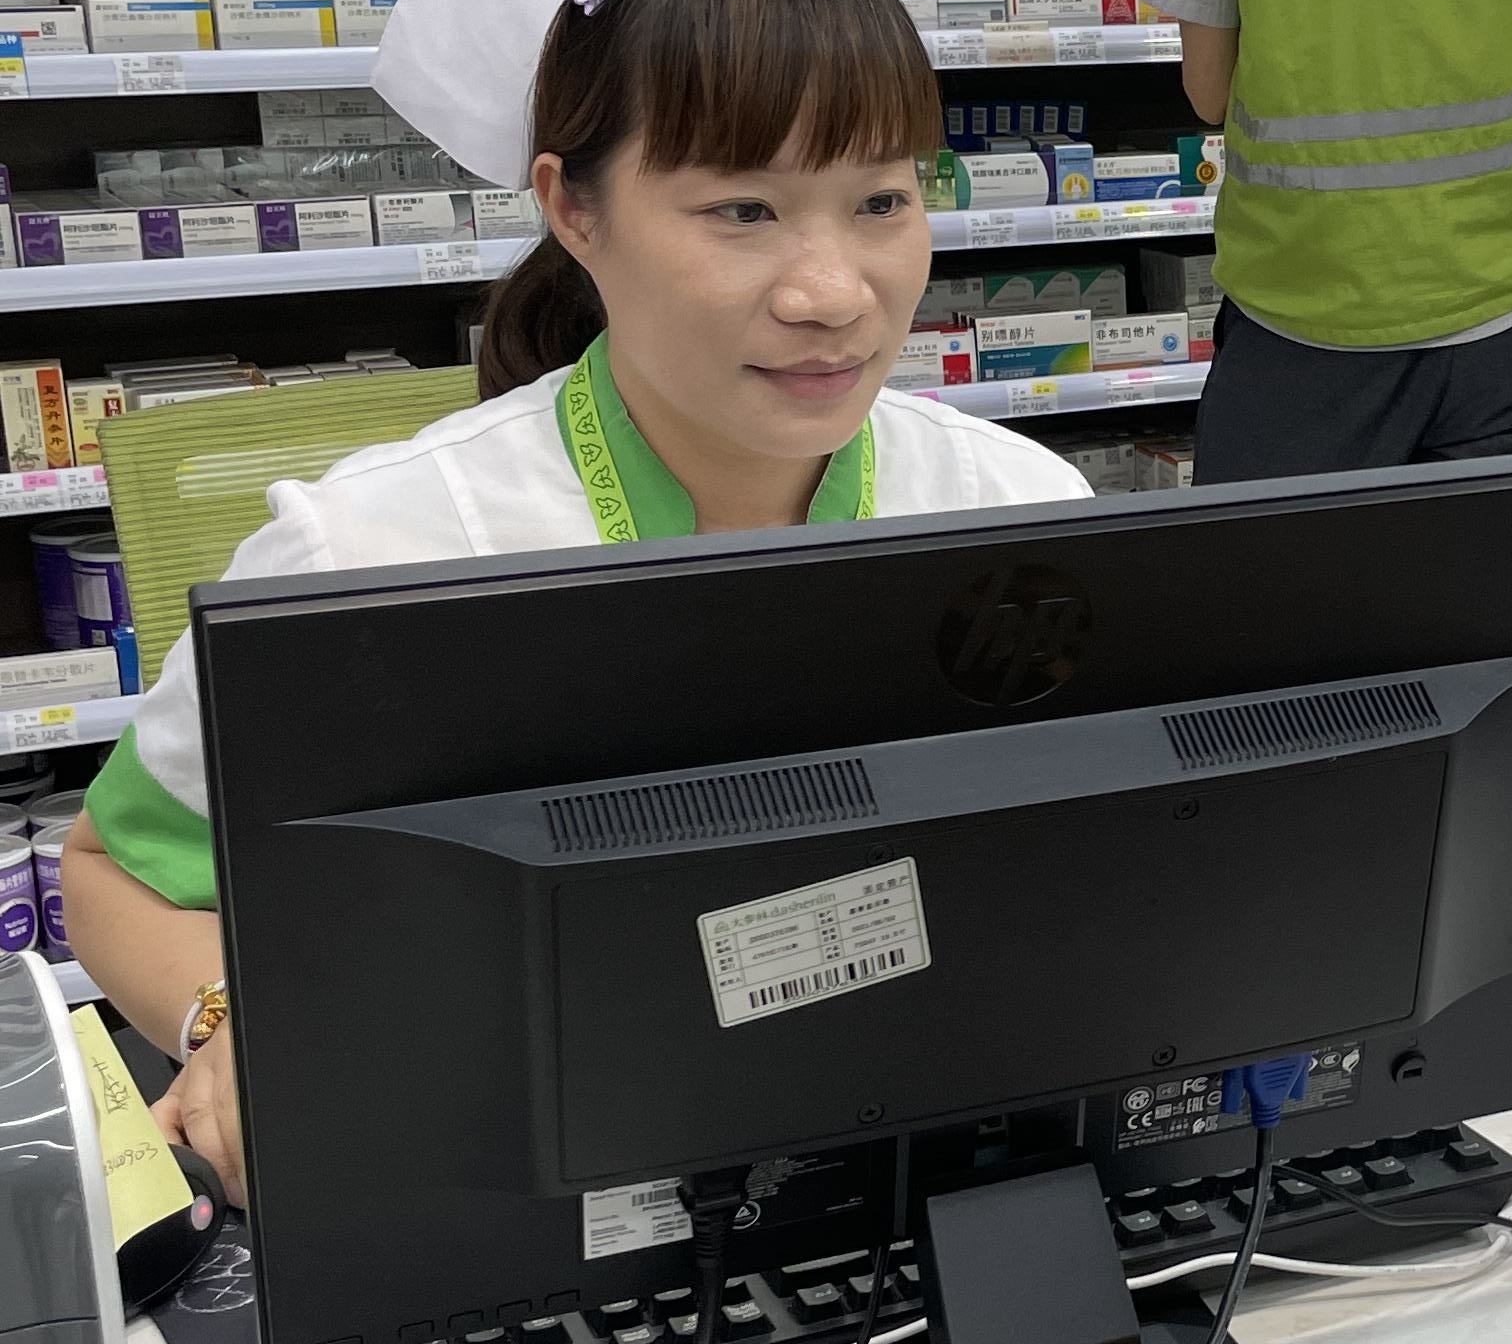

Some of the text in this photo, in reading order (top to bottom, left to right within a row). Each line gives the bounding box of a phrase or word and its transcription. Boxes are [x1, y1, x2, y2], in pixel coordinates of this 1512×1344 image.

[980, 327, 1036, 343] 别嘌醇片
[1095, 325, 1157, 342] 非布司他片
[42, 384, 65, 447] 复方丹参片
